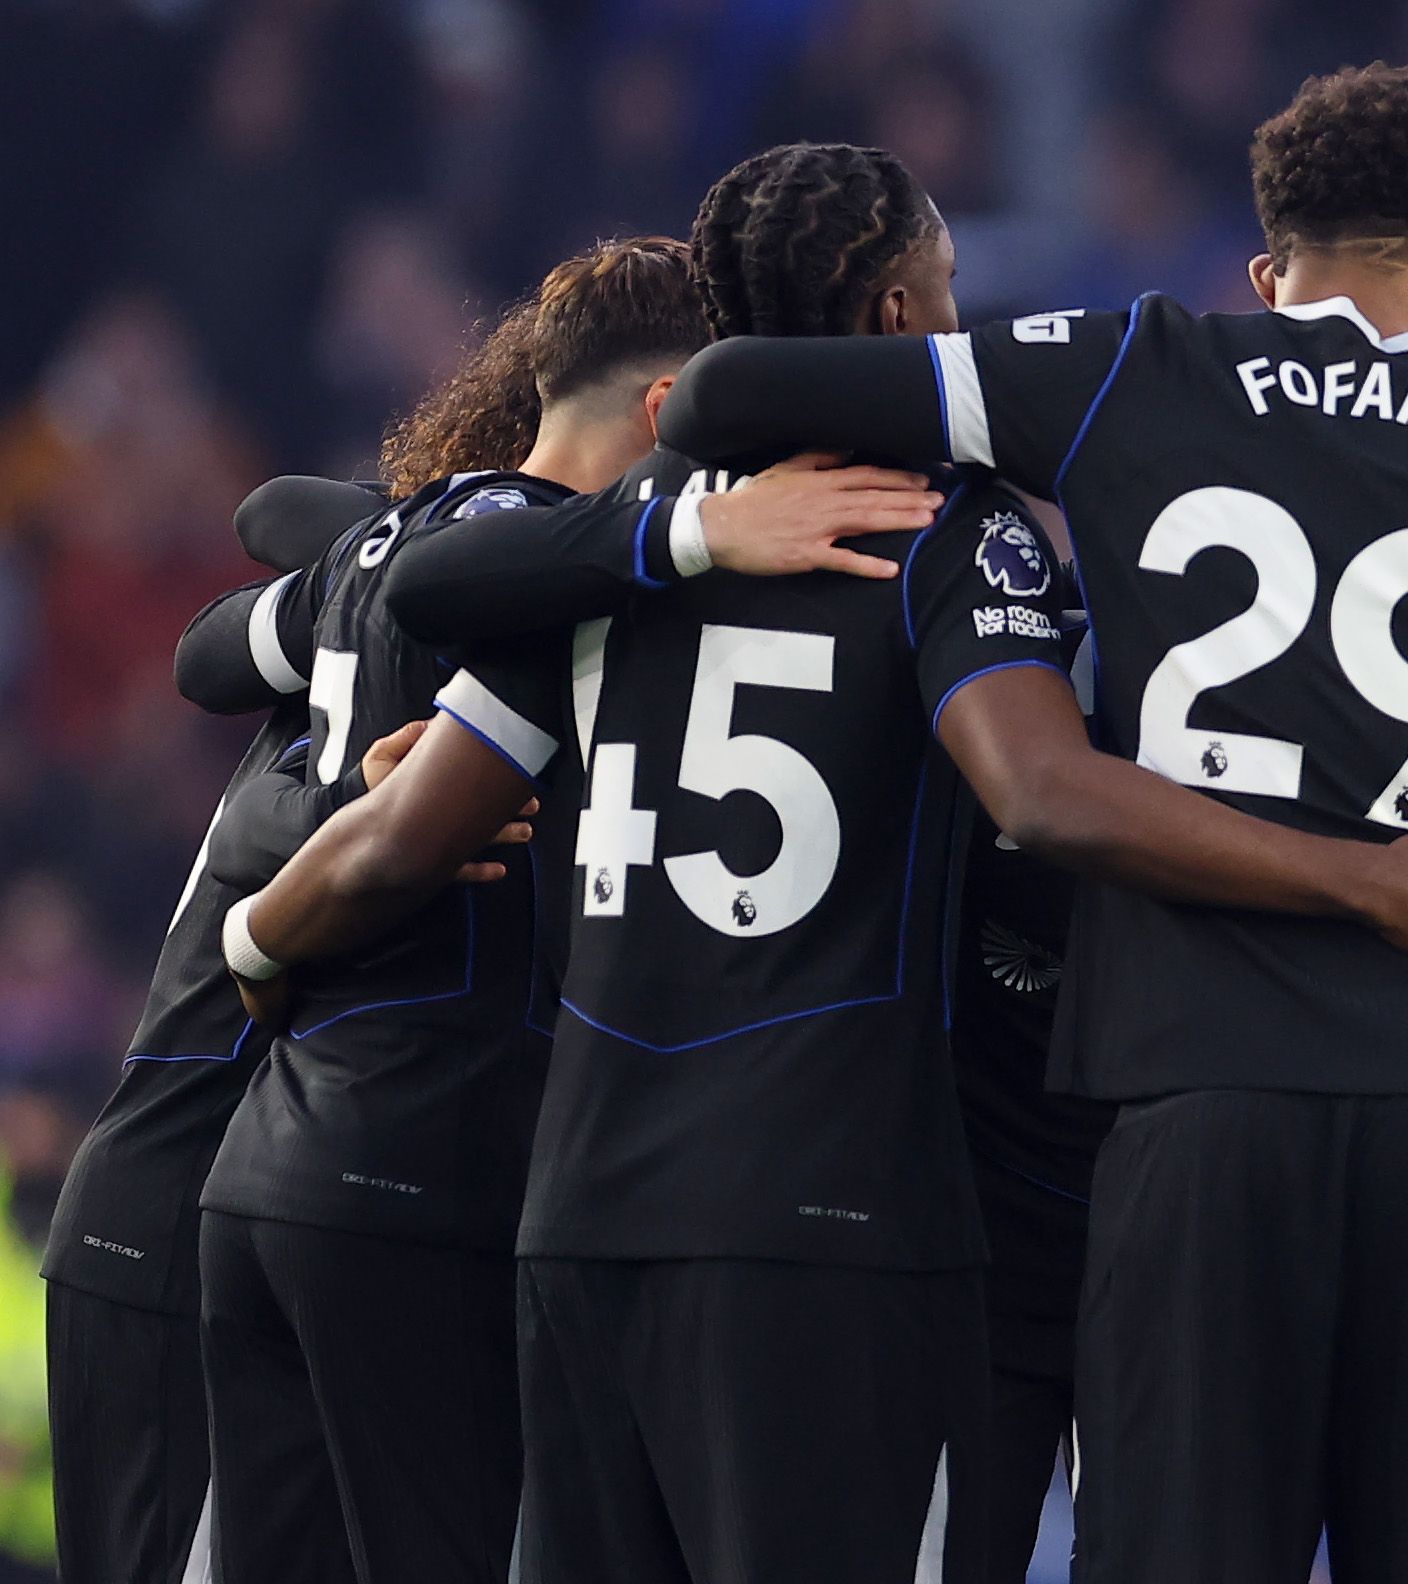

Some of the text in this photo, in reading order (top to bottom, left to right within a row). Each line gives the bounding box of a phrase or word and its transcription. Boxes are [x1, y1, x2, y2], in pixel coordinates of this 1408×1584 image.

[973, 606, 1050, 627] No room
[976, 619, 1005, 638] for
[571, 616, 841, 938] 45
